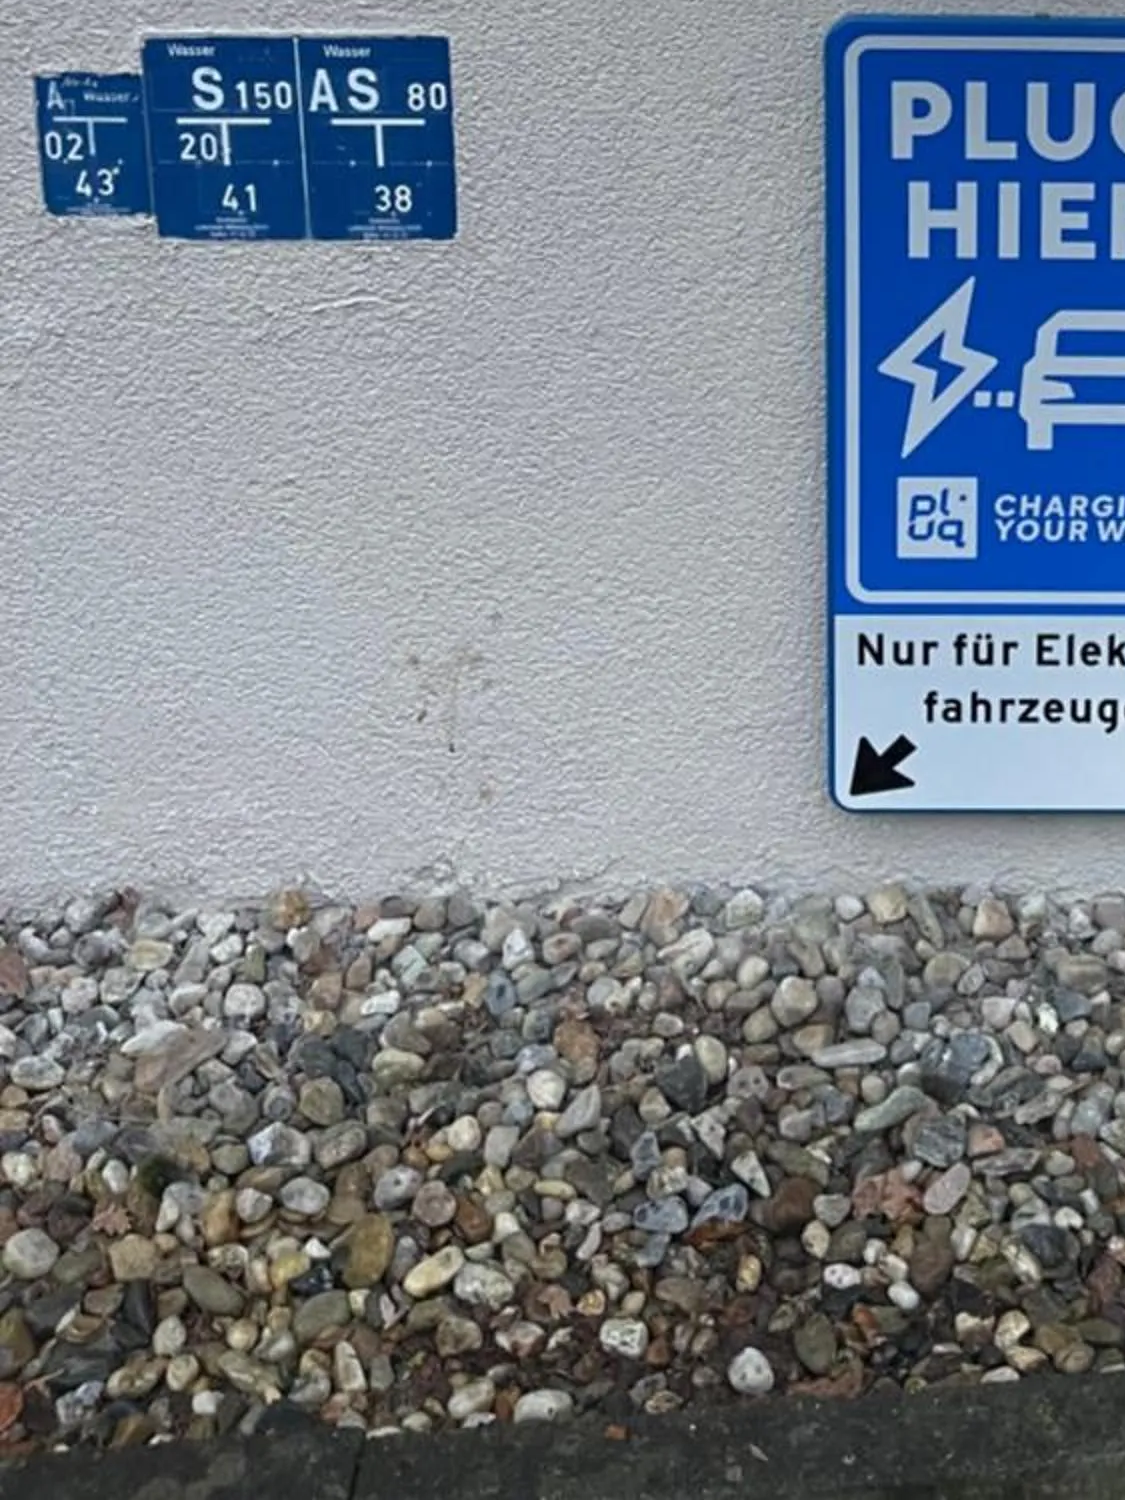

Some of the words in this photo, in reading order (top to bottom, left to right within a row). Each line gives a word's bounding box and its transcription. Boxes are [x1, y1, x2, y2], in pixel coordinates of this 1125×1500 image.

[166, 43, 216, 57] Wasser
[322, 45, 371, 58] Wasser
[47, 80, 64, 110] A
[192, 66, 225, 111] S
[235, 80, 293, 111] 150
[407, 82, 447, 112] 80
[995, 519, 1088, 542] YOUR
[857, 632, 938, 667] Nur
[953, 633, 1019, 667] für
